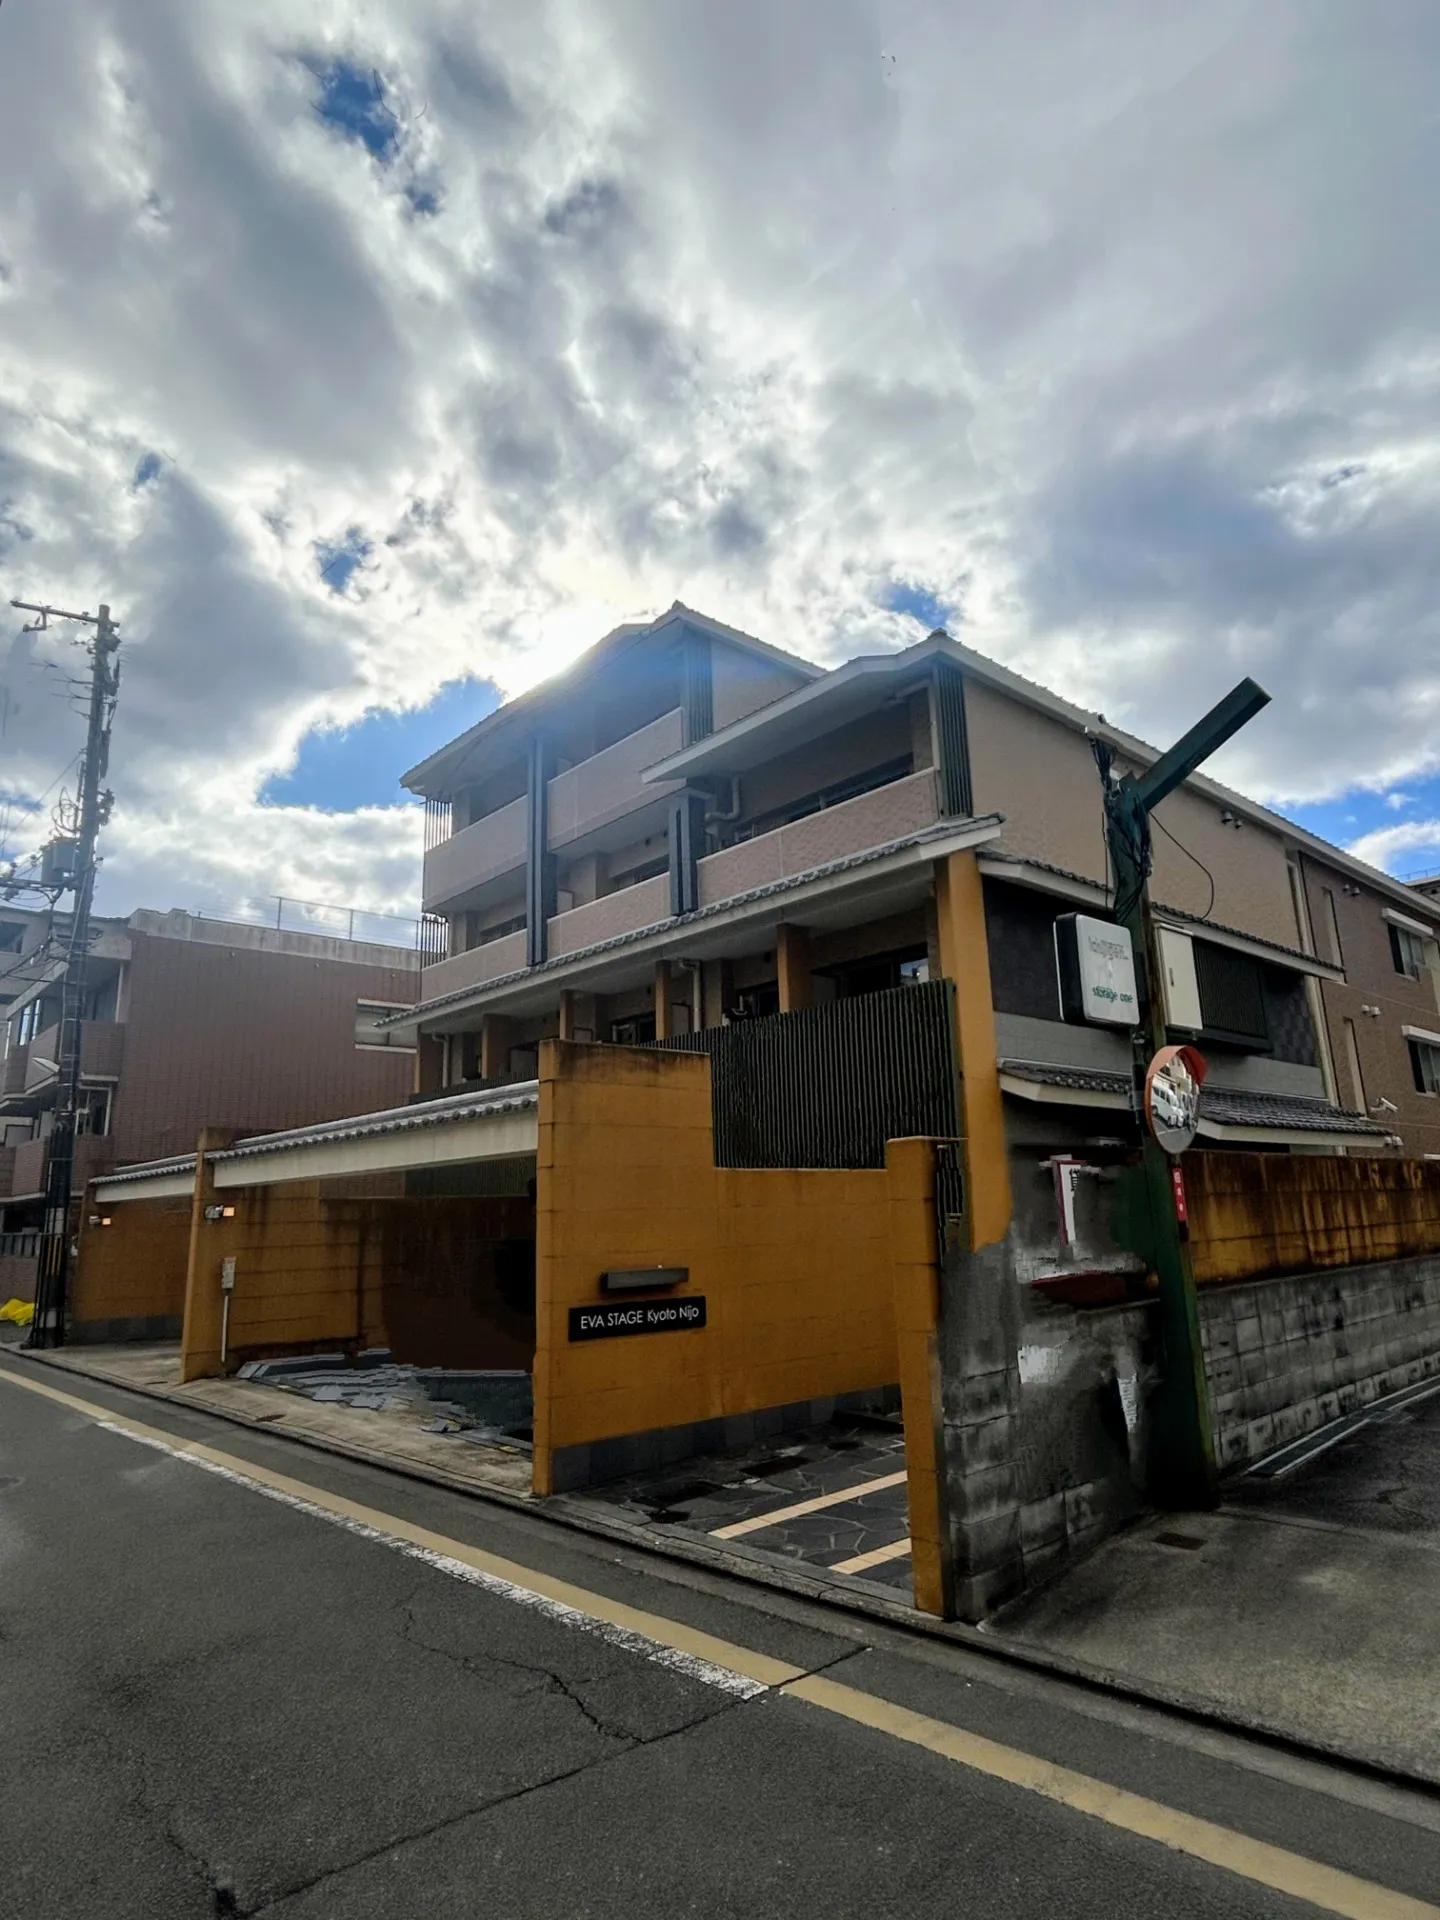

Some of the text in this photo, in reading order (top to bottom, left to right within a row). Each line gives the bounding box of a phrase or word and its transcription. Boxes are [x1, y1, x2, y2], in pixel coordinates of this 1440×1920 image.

[580, 1305, 699, 1330] EVA STAGE Kyoto Nijo
